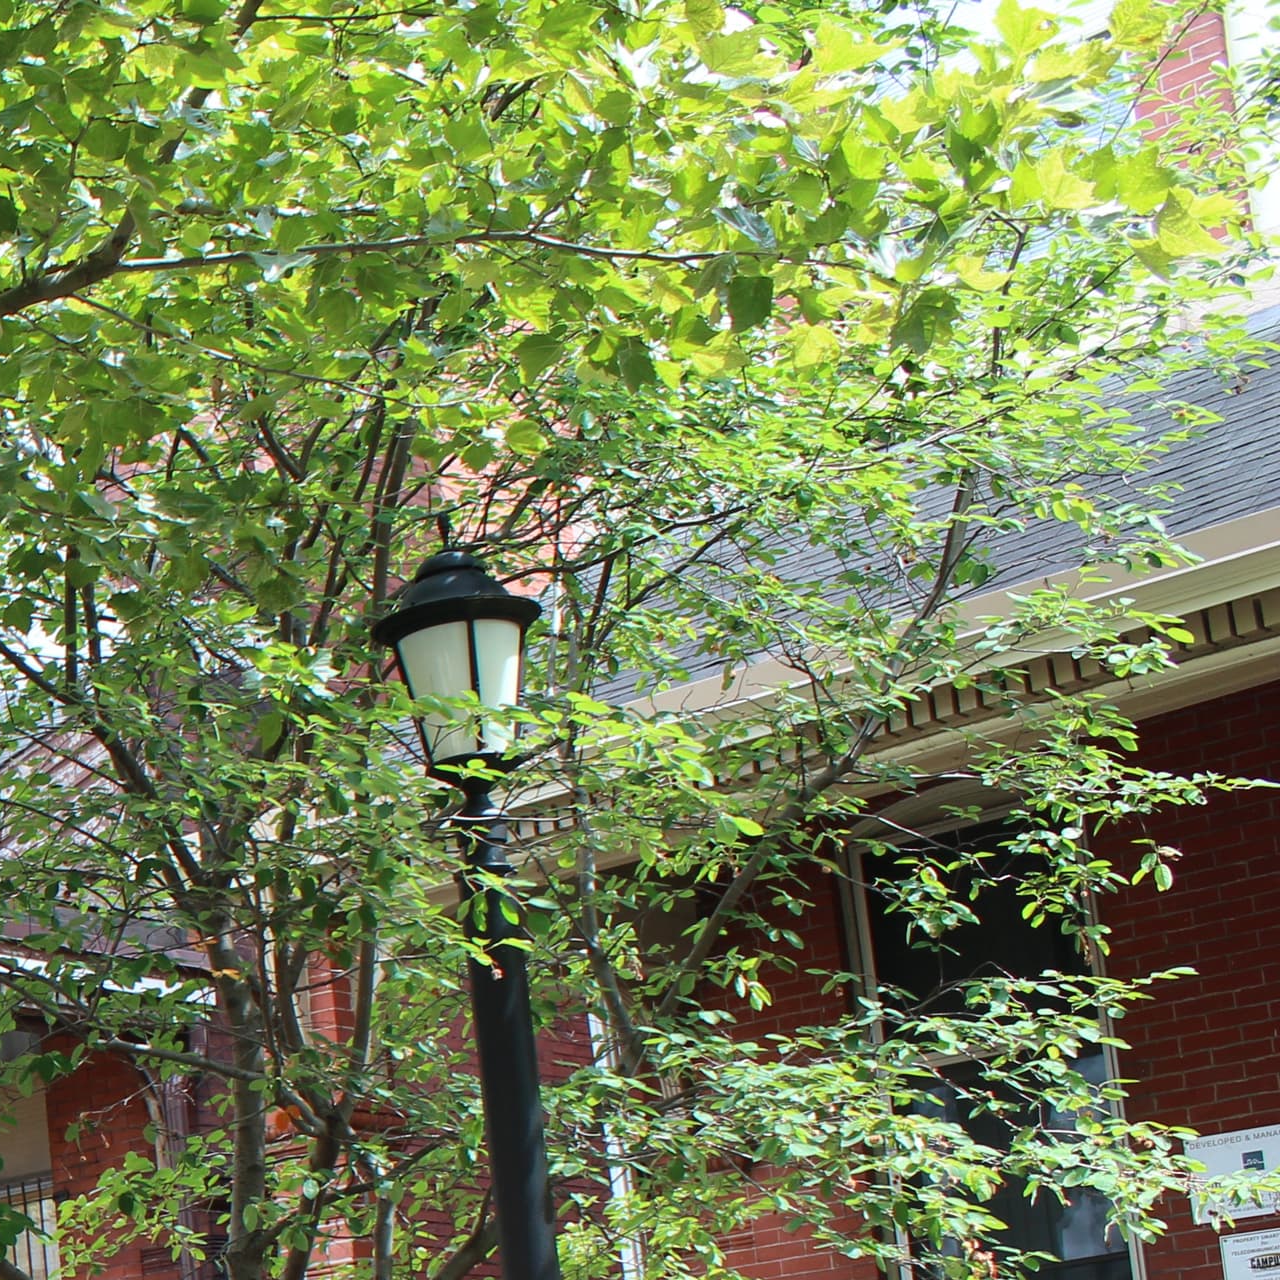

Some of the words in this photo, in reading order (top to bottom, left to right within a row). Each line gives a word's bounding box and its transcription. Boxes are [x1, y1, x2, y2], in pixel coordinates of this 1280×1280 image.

[1189, 1135, 1242, 1150] DEVELOPED
[1244, 1134, 1250, 1142] &
[1253, 1129, 1280, 1140] MANA
[1250, 1256, 1280, 1270] CAMPU
